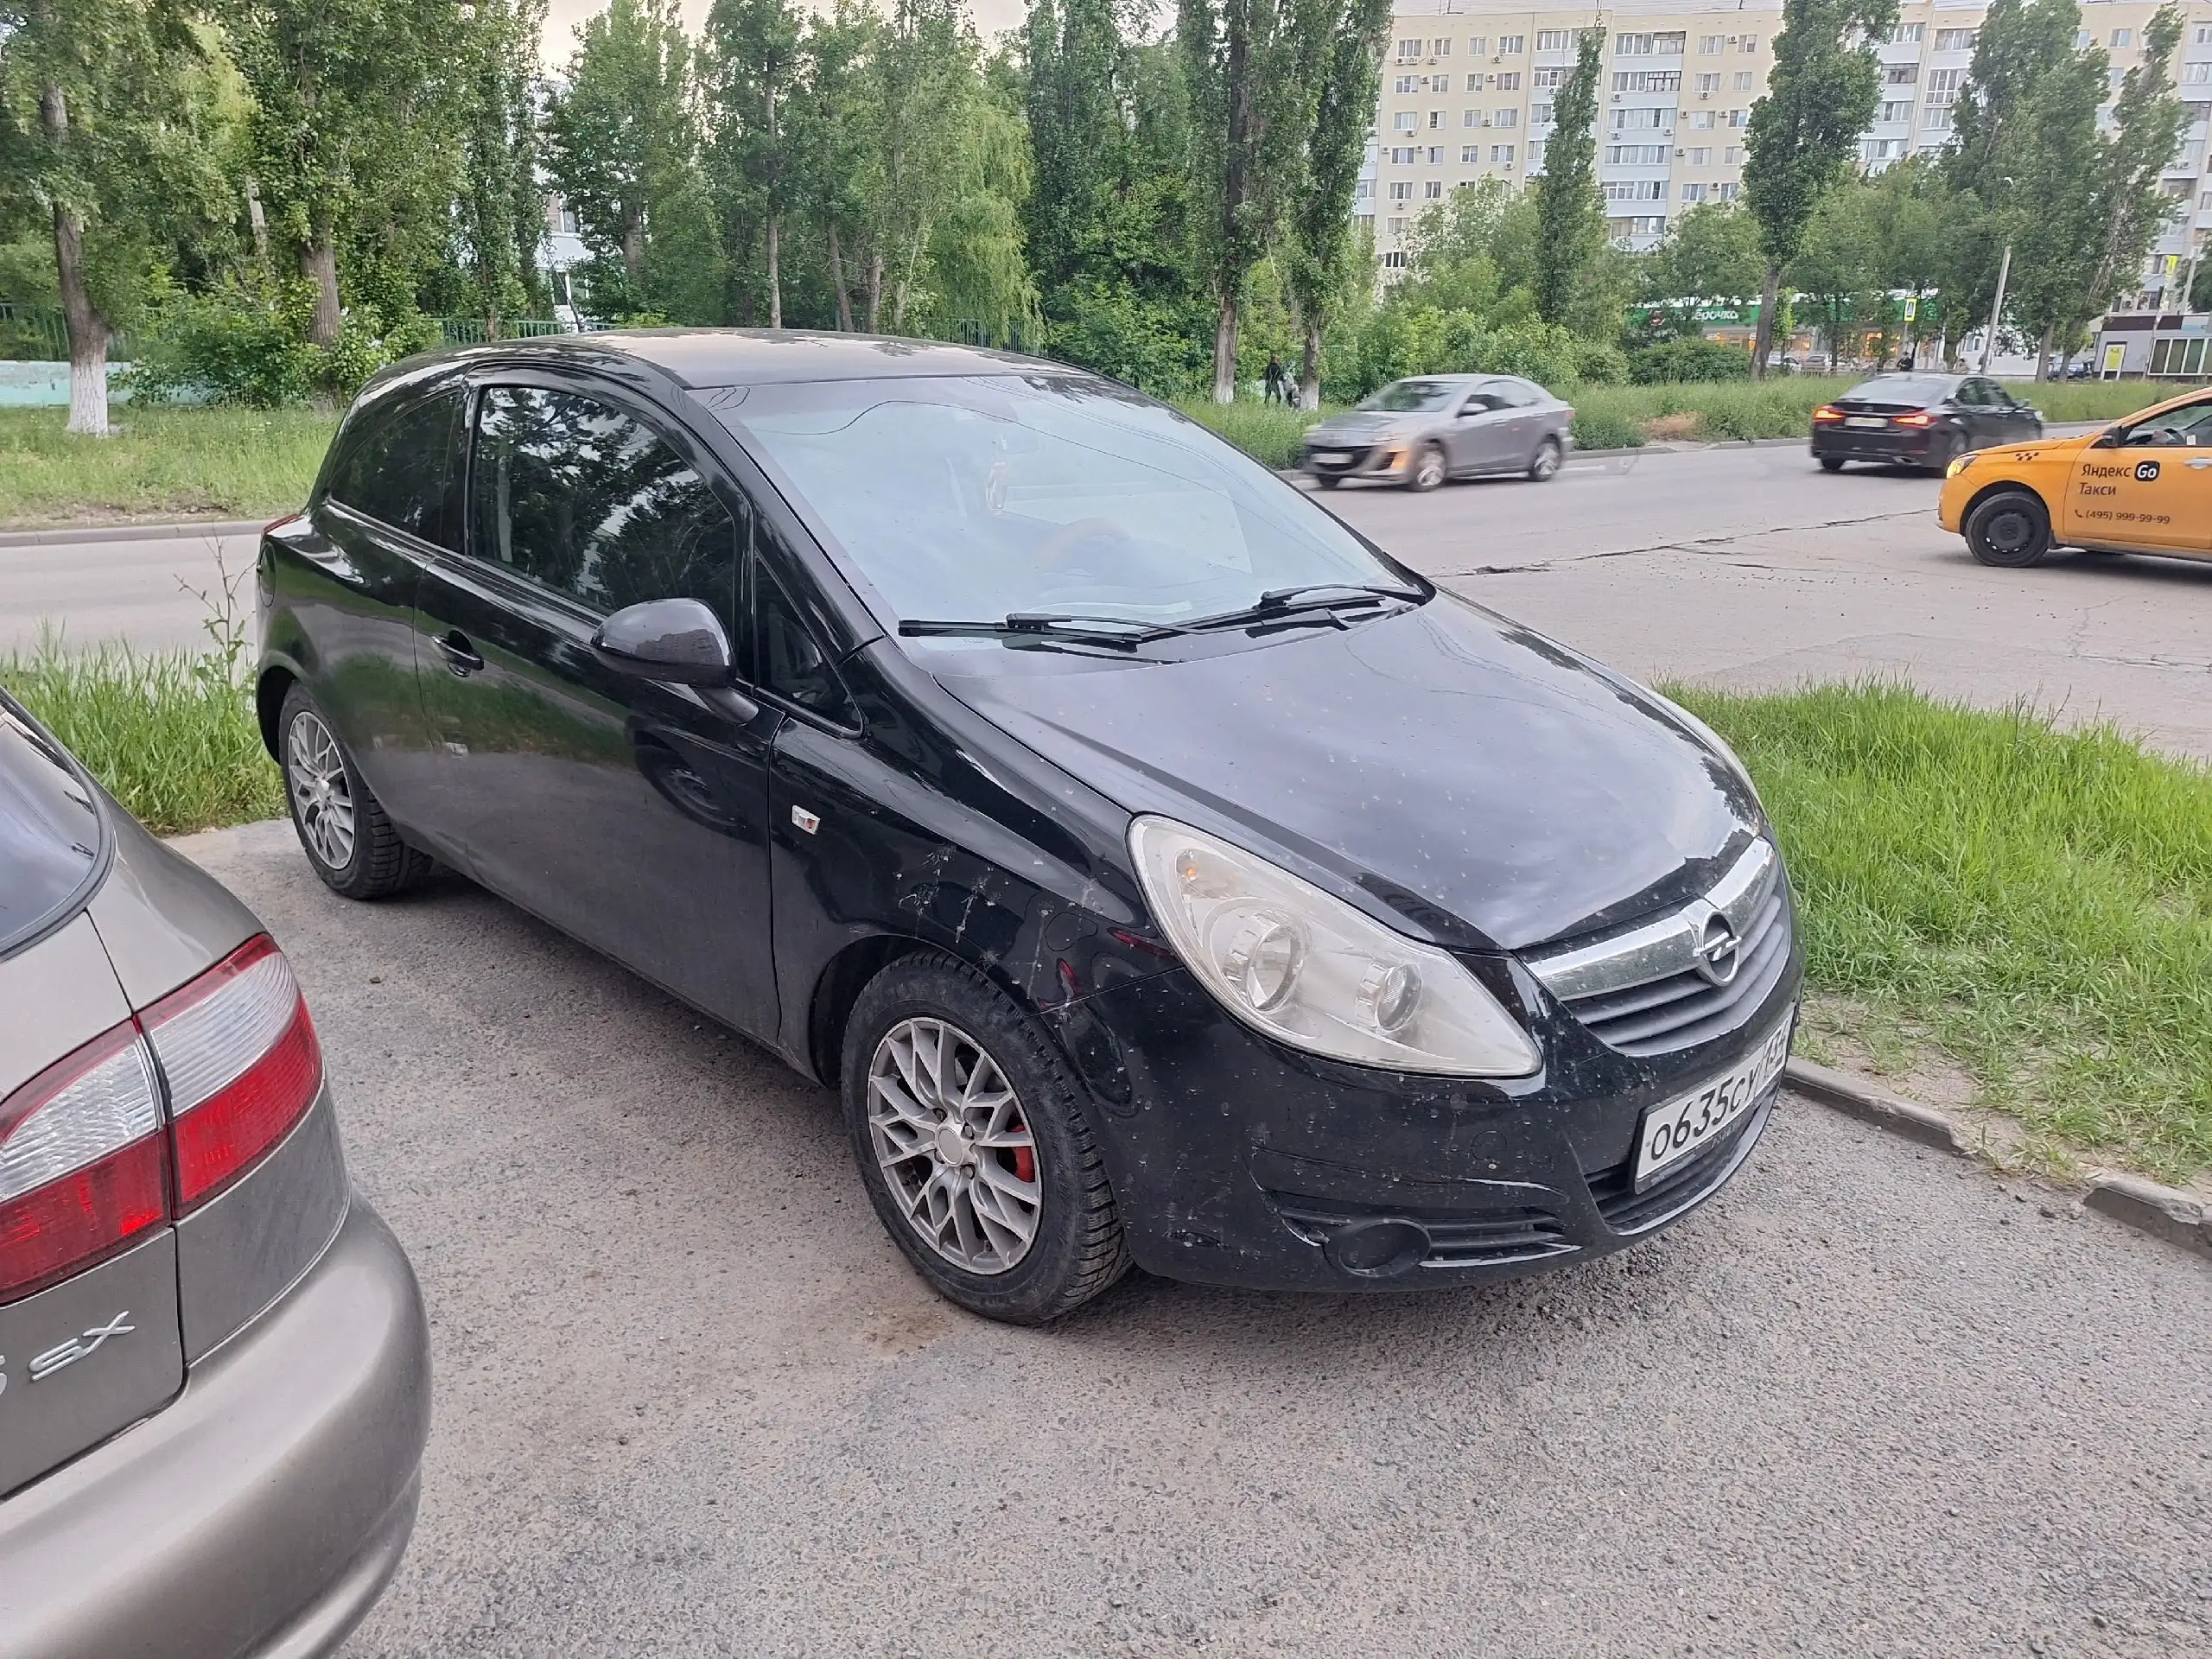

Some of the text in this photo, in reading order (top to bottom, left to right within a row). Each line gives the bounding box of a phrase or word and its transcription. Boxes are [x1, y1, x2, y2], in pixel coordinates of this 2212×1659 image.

[1676, 309, 1739, 322] ёрочка
[2081, 464, 2158, 479] Яндекс Go
[2079, 482, 2116, 495] Такси
[2086, 511, 2171, 524] (495) 999-99-99
[29, 1310, 136, 1382] SX
